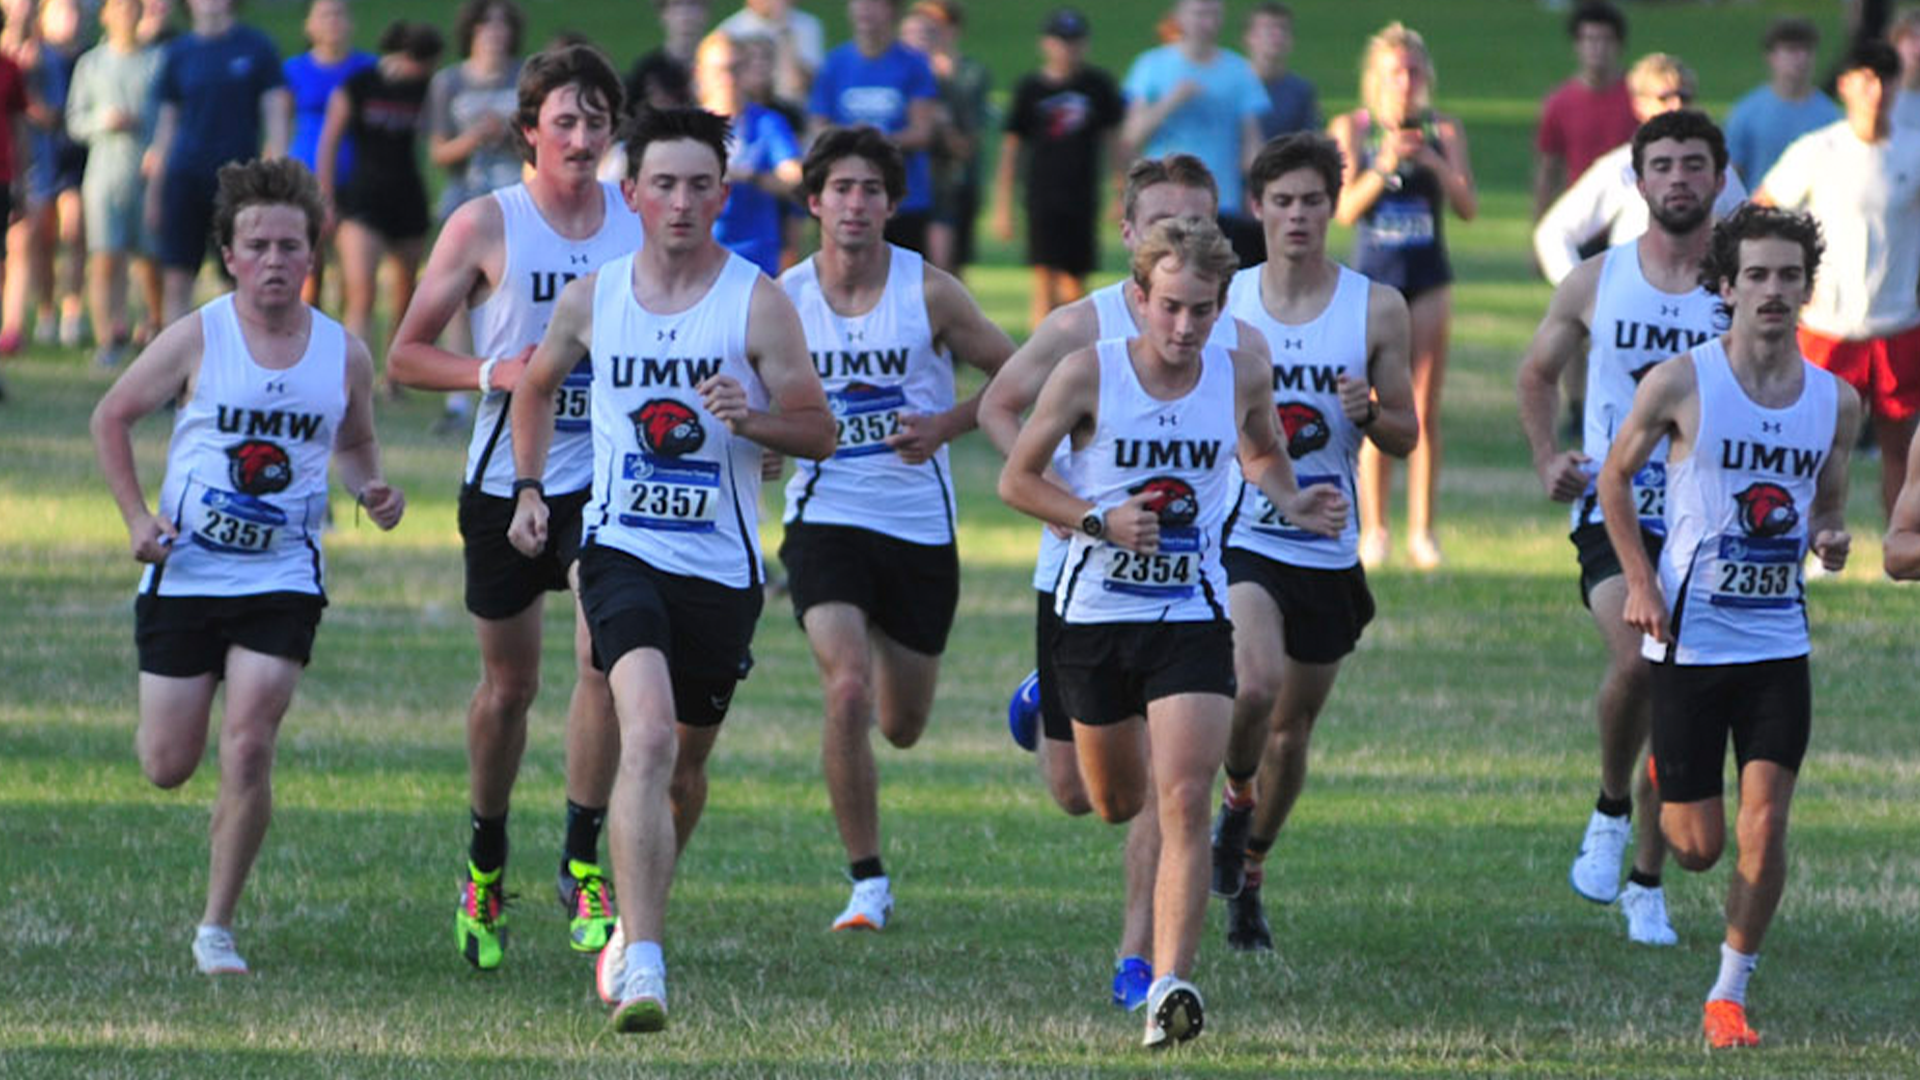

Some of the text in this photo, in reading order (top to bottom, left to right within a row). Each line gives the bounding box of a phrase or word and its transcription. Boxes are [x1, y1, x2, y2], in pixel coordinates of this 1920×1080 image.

[611, 355, 722, 388] UMW
[811, 348, 908, 378] UMW
[217, 404, 323, 441] UMW
[1115, 438, 1221, 469] UMW
[1722, 439, 1822, 478] UMW
[630, 483, 708, 517] 2357
[203, 510, 274, 549] 2351
[1111, 551, 1190, 583] 2354
[1719, 562, 1790, 595] 2353
